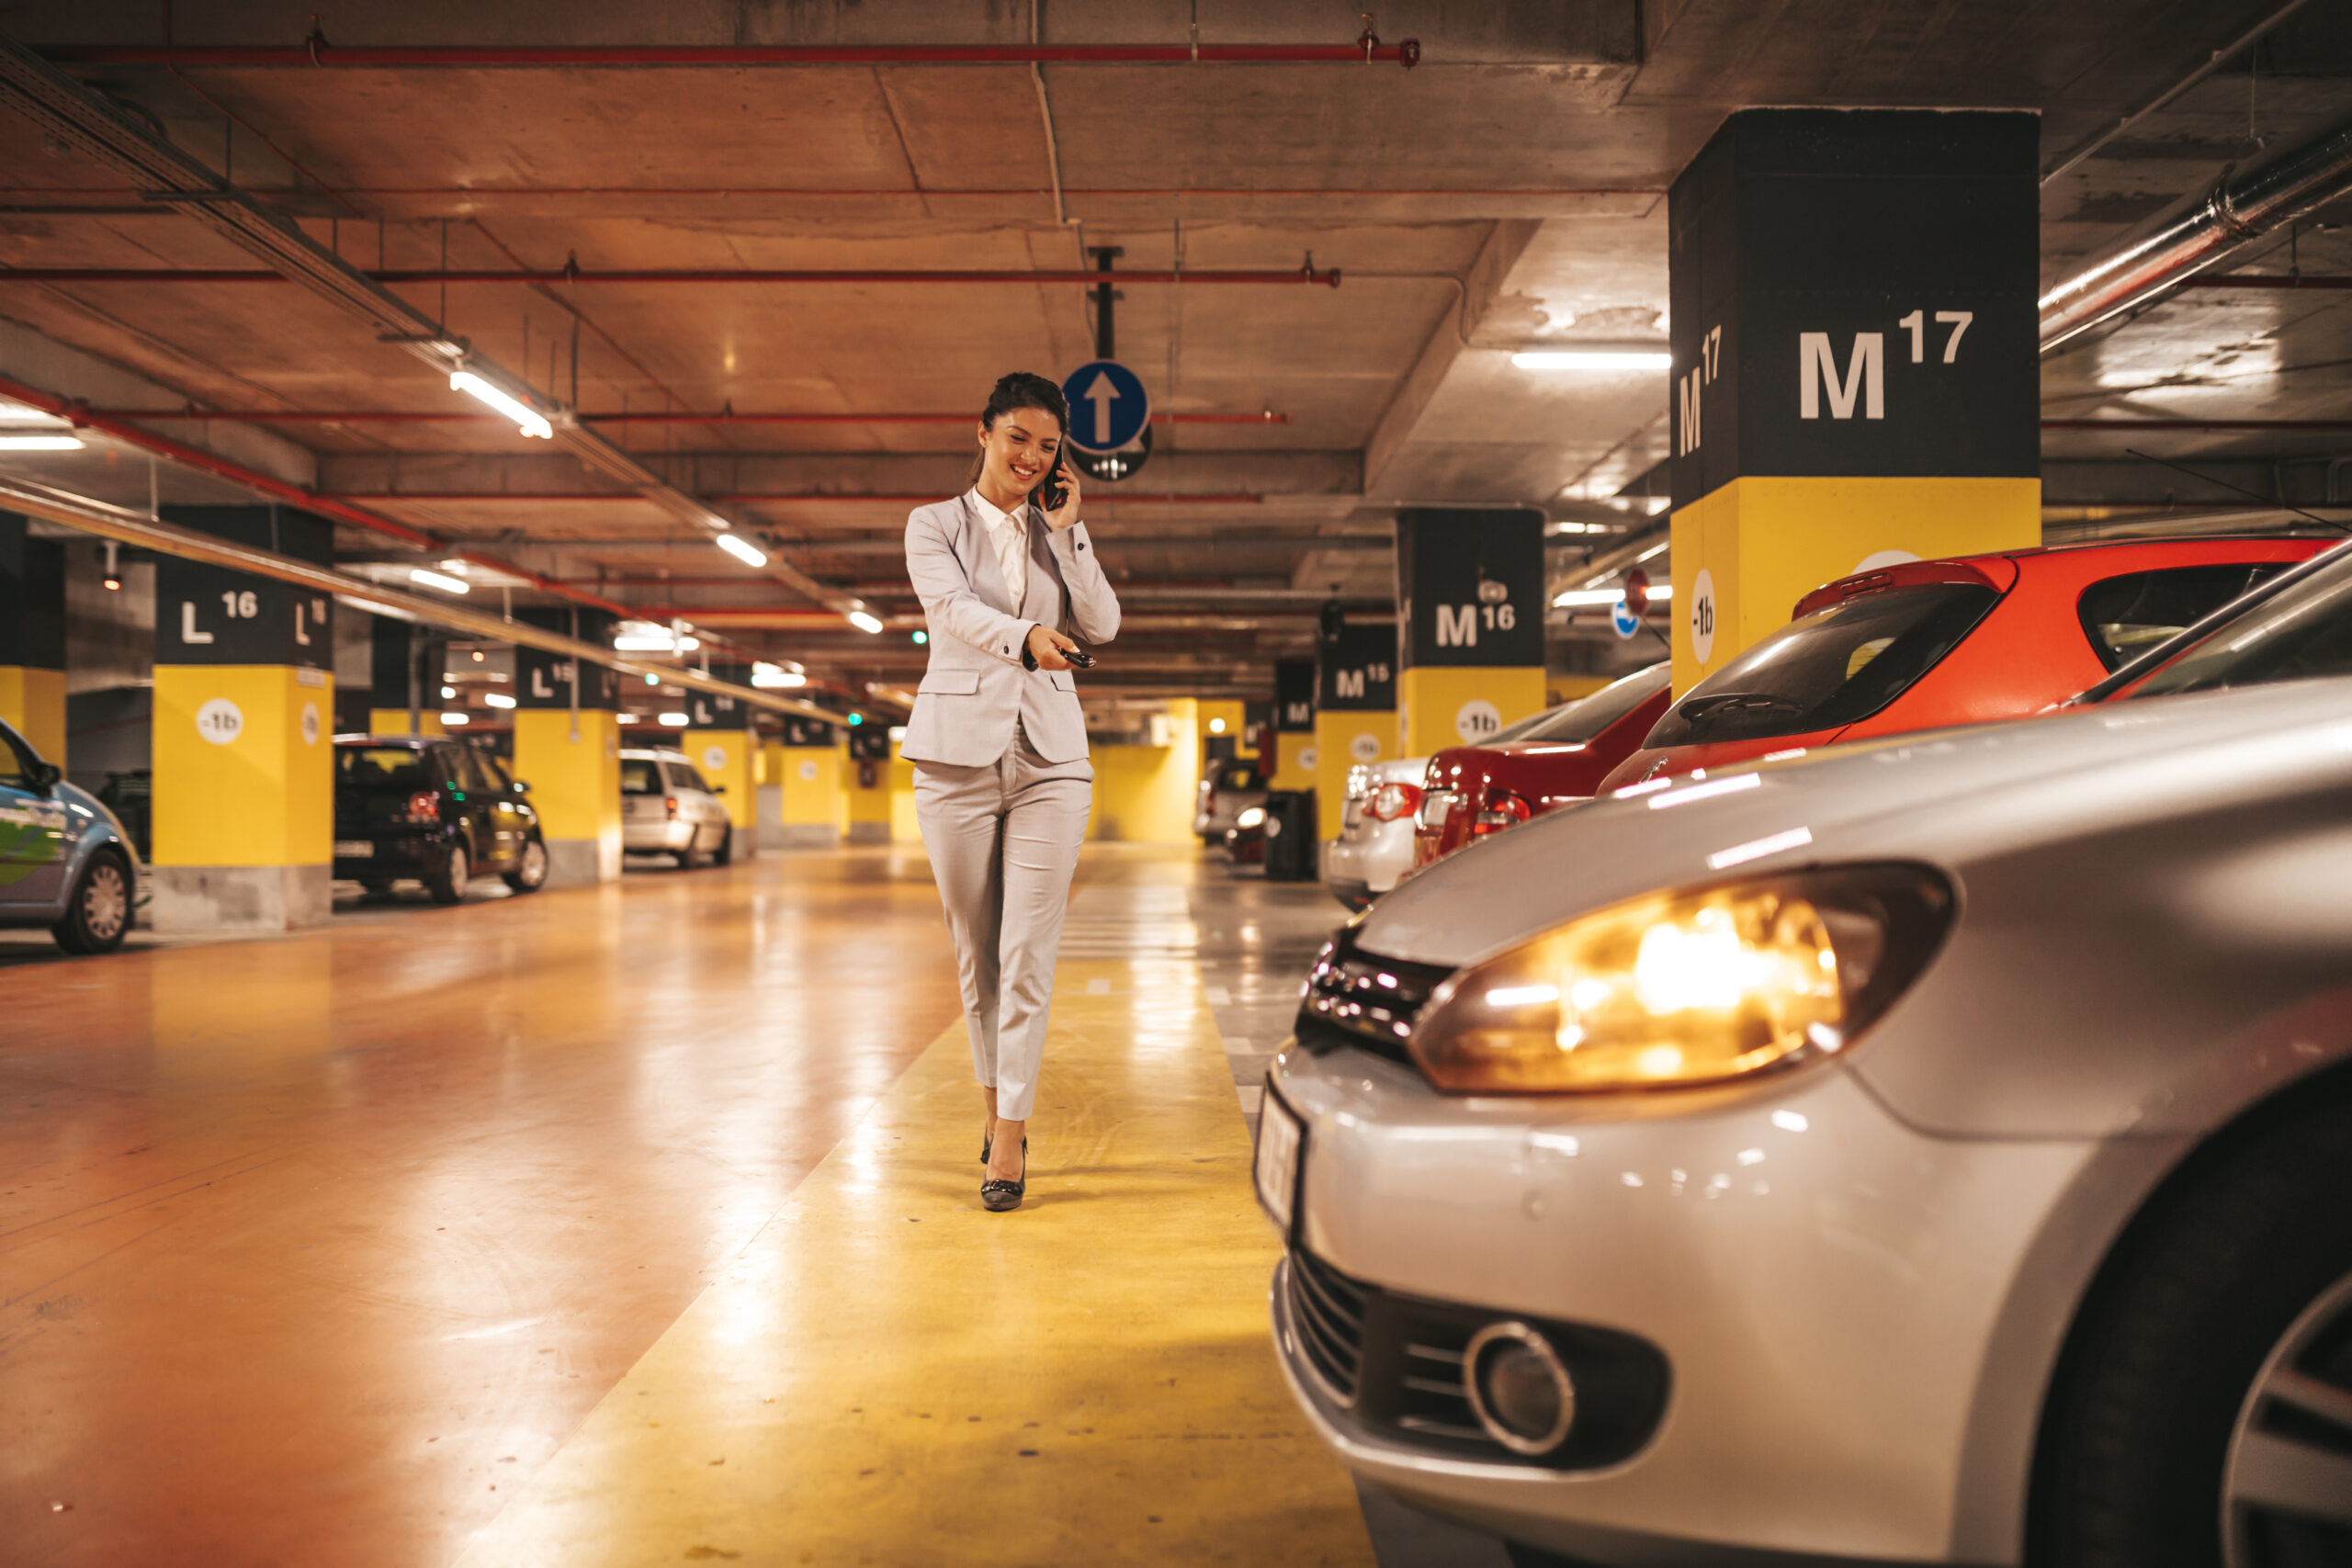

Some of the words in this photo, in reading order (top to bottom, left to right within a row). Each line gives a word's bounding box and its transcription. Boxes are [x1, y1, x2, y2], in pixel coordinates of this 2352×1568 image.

[1680, 324, 1722, 457] M17
[1799, 310, 1973, 420] M17
[182, 591, 258, 644] L16
[1436, 604, 1516, 647] M16
[1692, 595, 1713, 636] -1b
